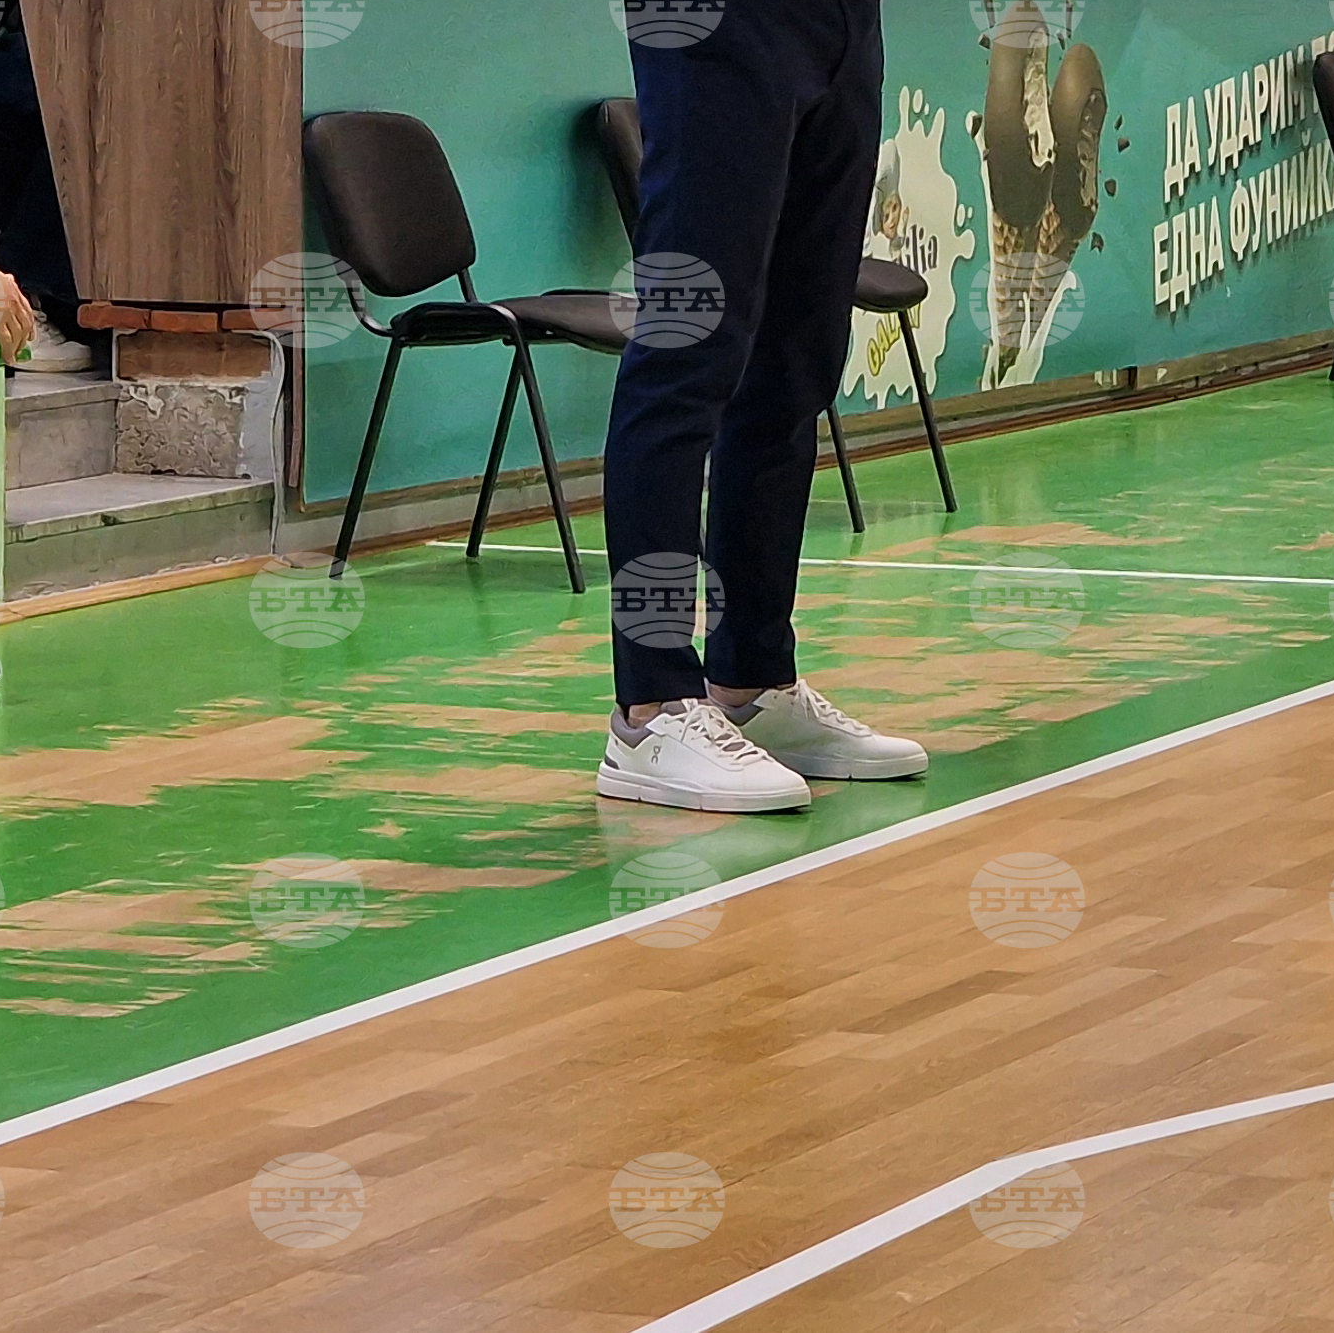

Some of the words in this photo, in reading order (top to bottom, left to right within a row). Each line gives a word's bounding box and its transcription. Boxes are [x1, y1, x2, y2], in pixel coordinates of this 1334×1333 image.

[1164, 96, 1201, 203] ДА
[1204, 44, 1306, 176] УДАРИМ
[1154, 196, 1225, 312] ЕДНА
